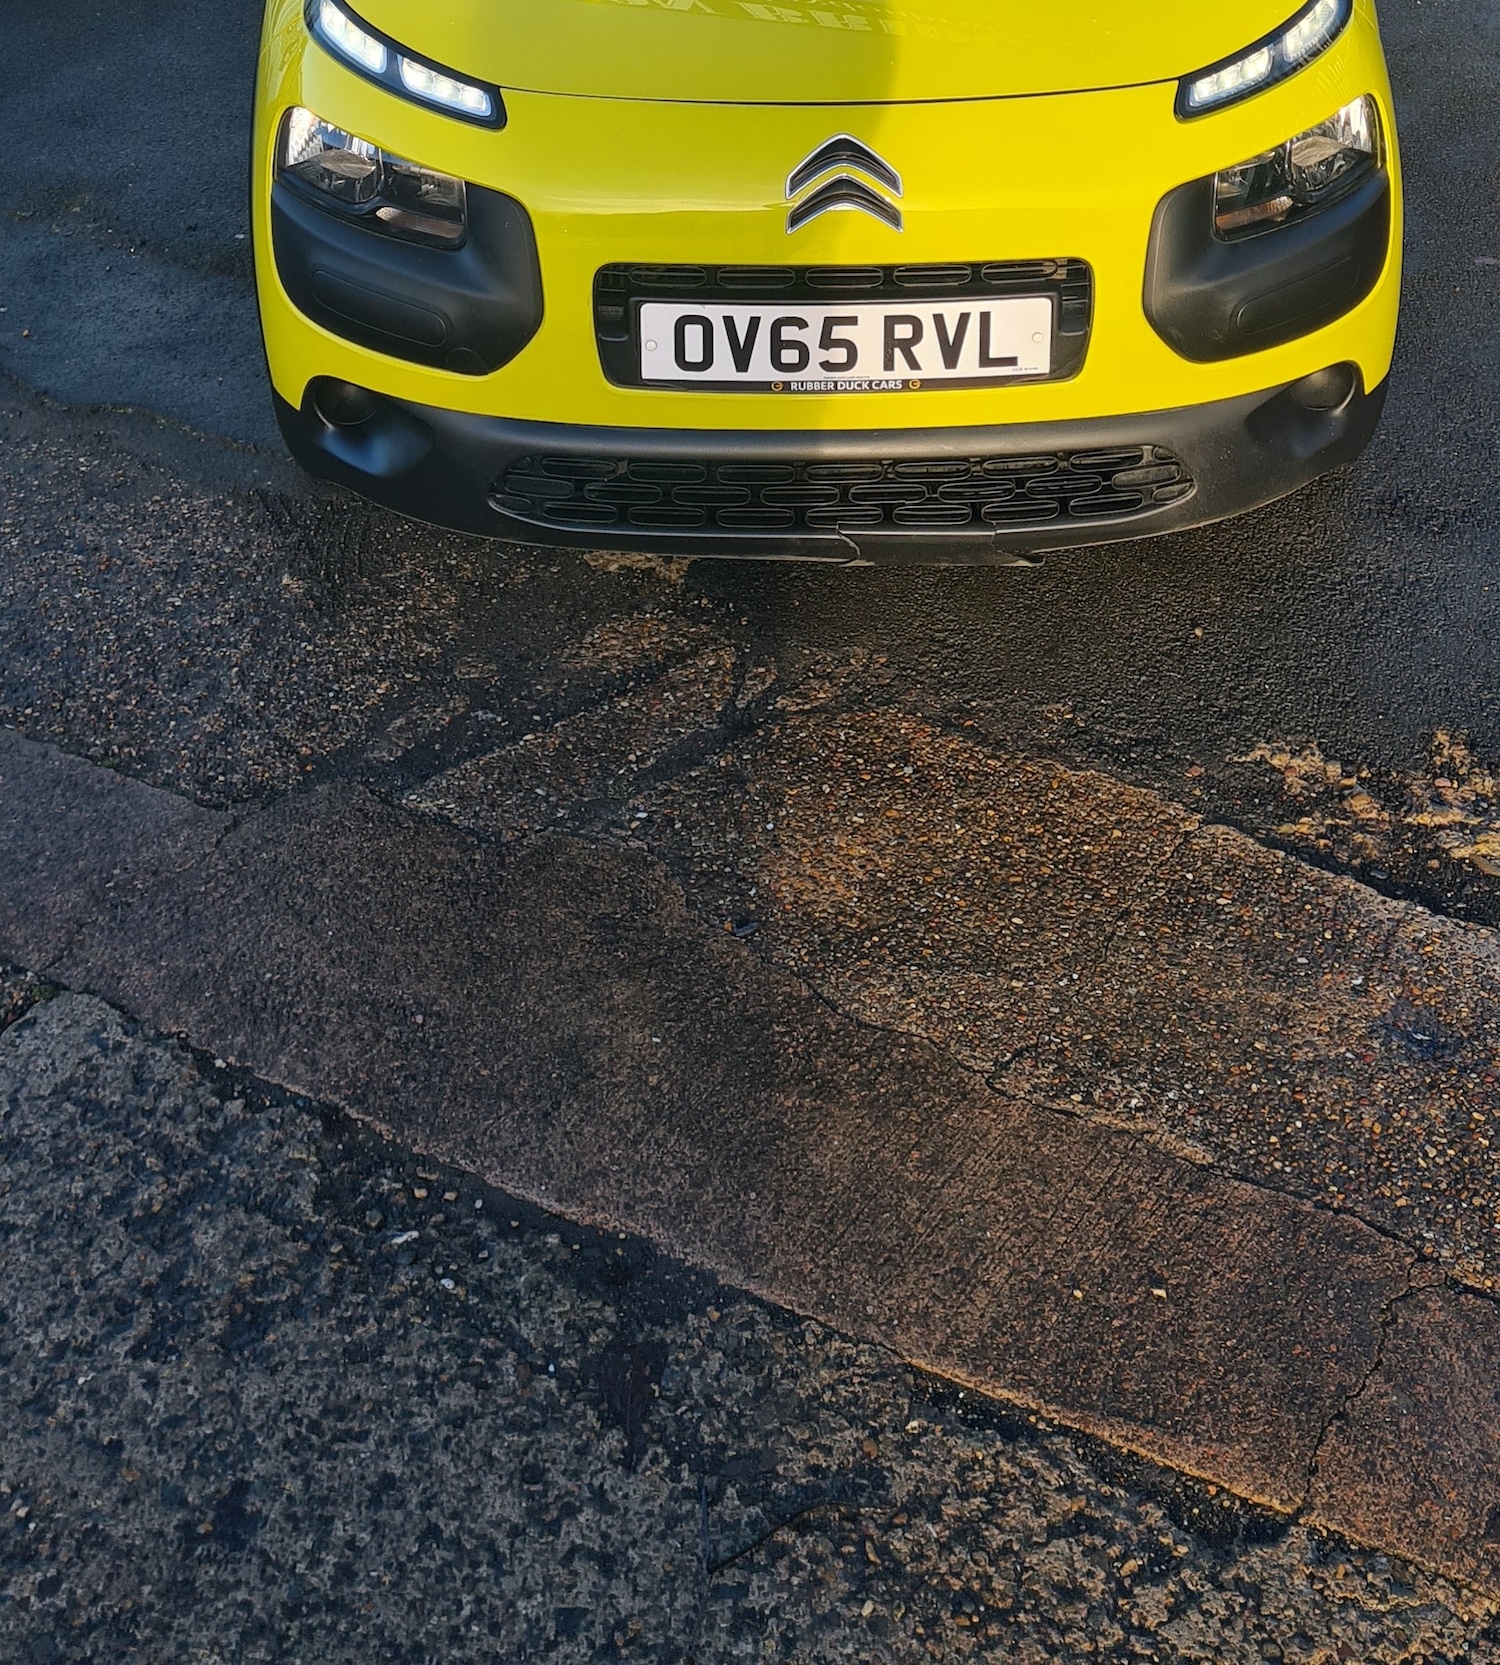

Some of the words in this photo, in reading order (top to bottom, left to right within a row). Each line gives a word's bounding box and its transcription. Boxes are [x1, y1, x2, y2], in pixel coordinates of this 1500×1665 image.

[673, 314, 859, 374] OV65
[883, 310, 1019, 372] RVL
[790, 381, 835, 391] RUBBER
[837, 380, 870, 390] DUCK
[872, 379, 903, 390] CARS
